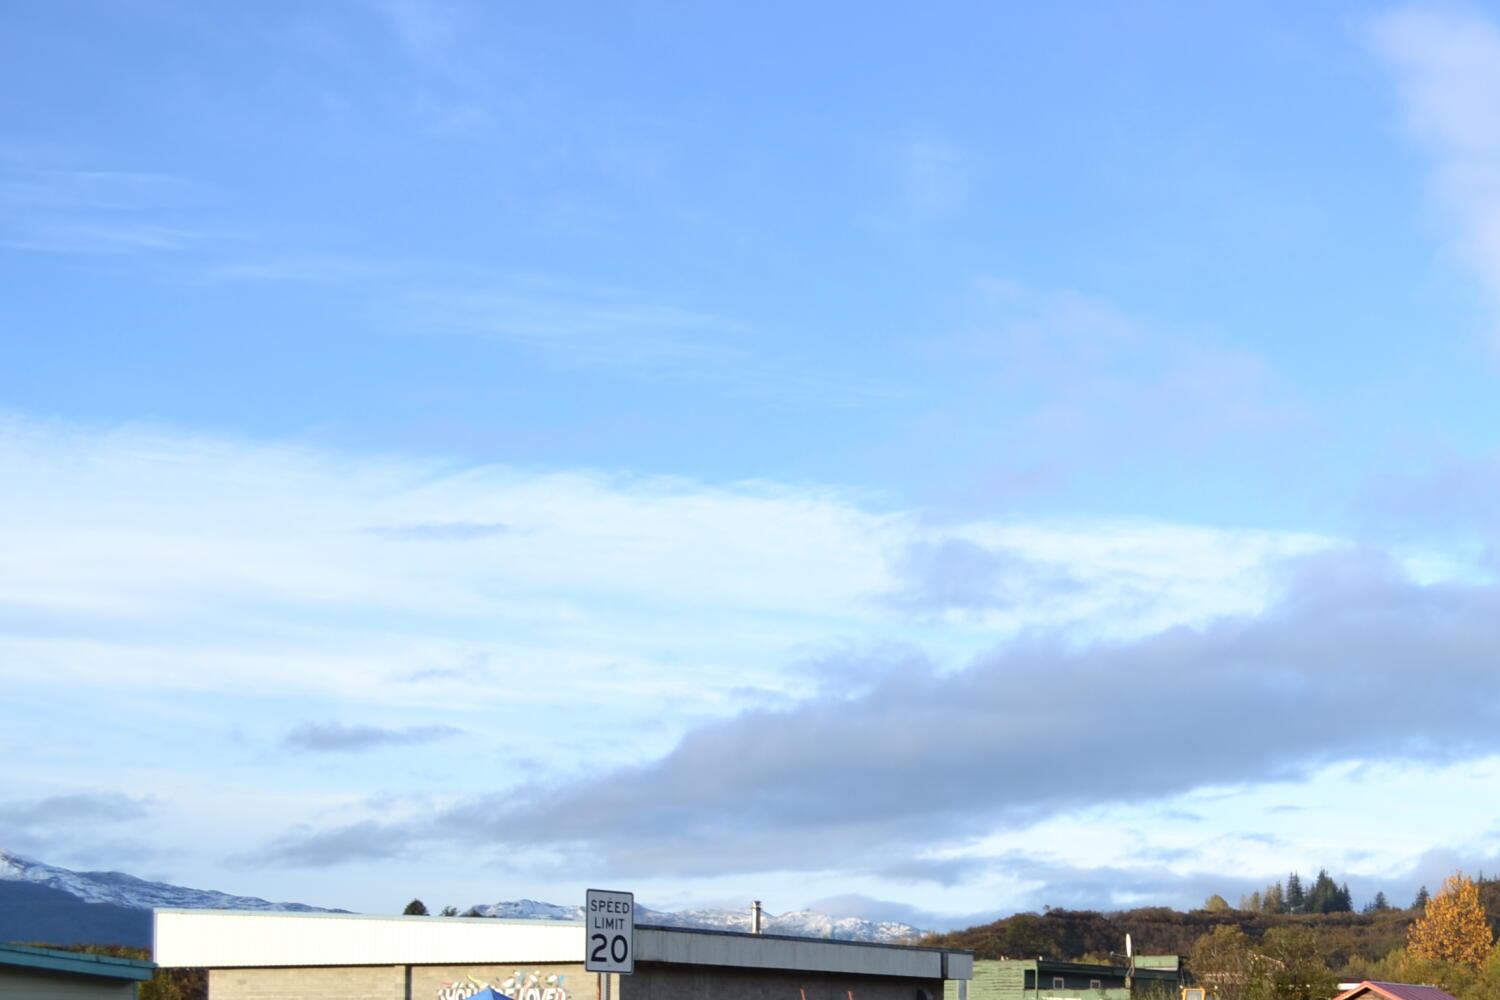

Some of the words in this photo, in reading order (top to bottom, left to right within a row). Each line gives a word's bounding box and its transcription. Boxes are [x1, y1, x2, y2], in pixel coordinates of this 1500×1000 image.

[590, 899, 630, 914] SPEED
[594, 916, 625, 930] LIMIT
[591, 933, 628, 963] 20
